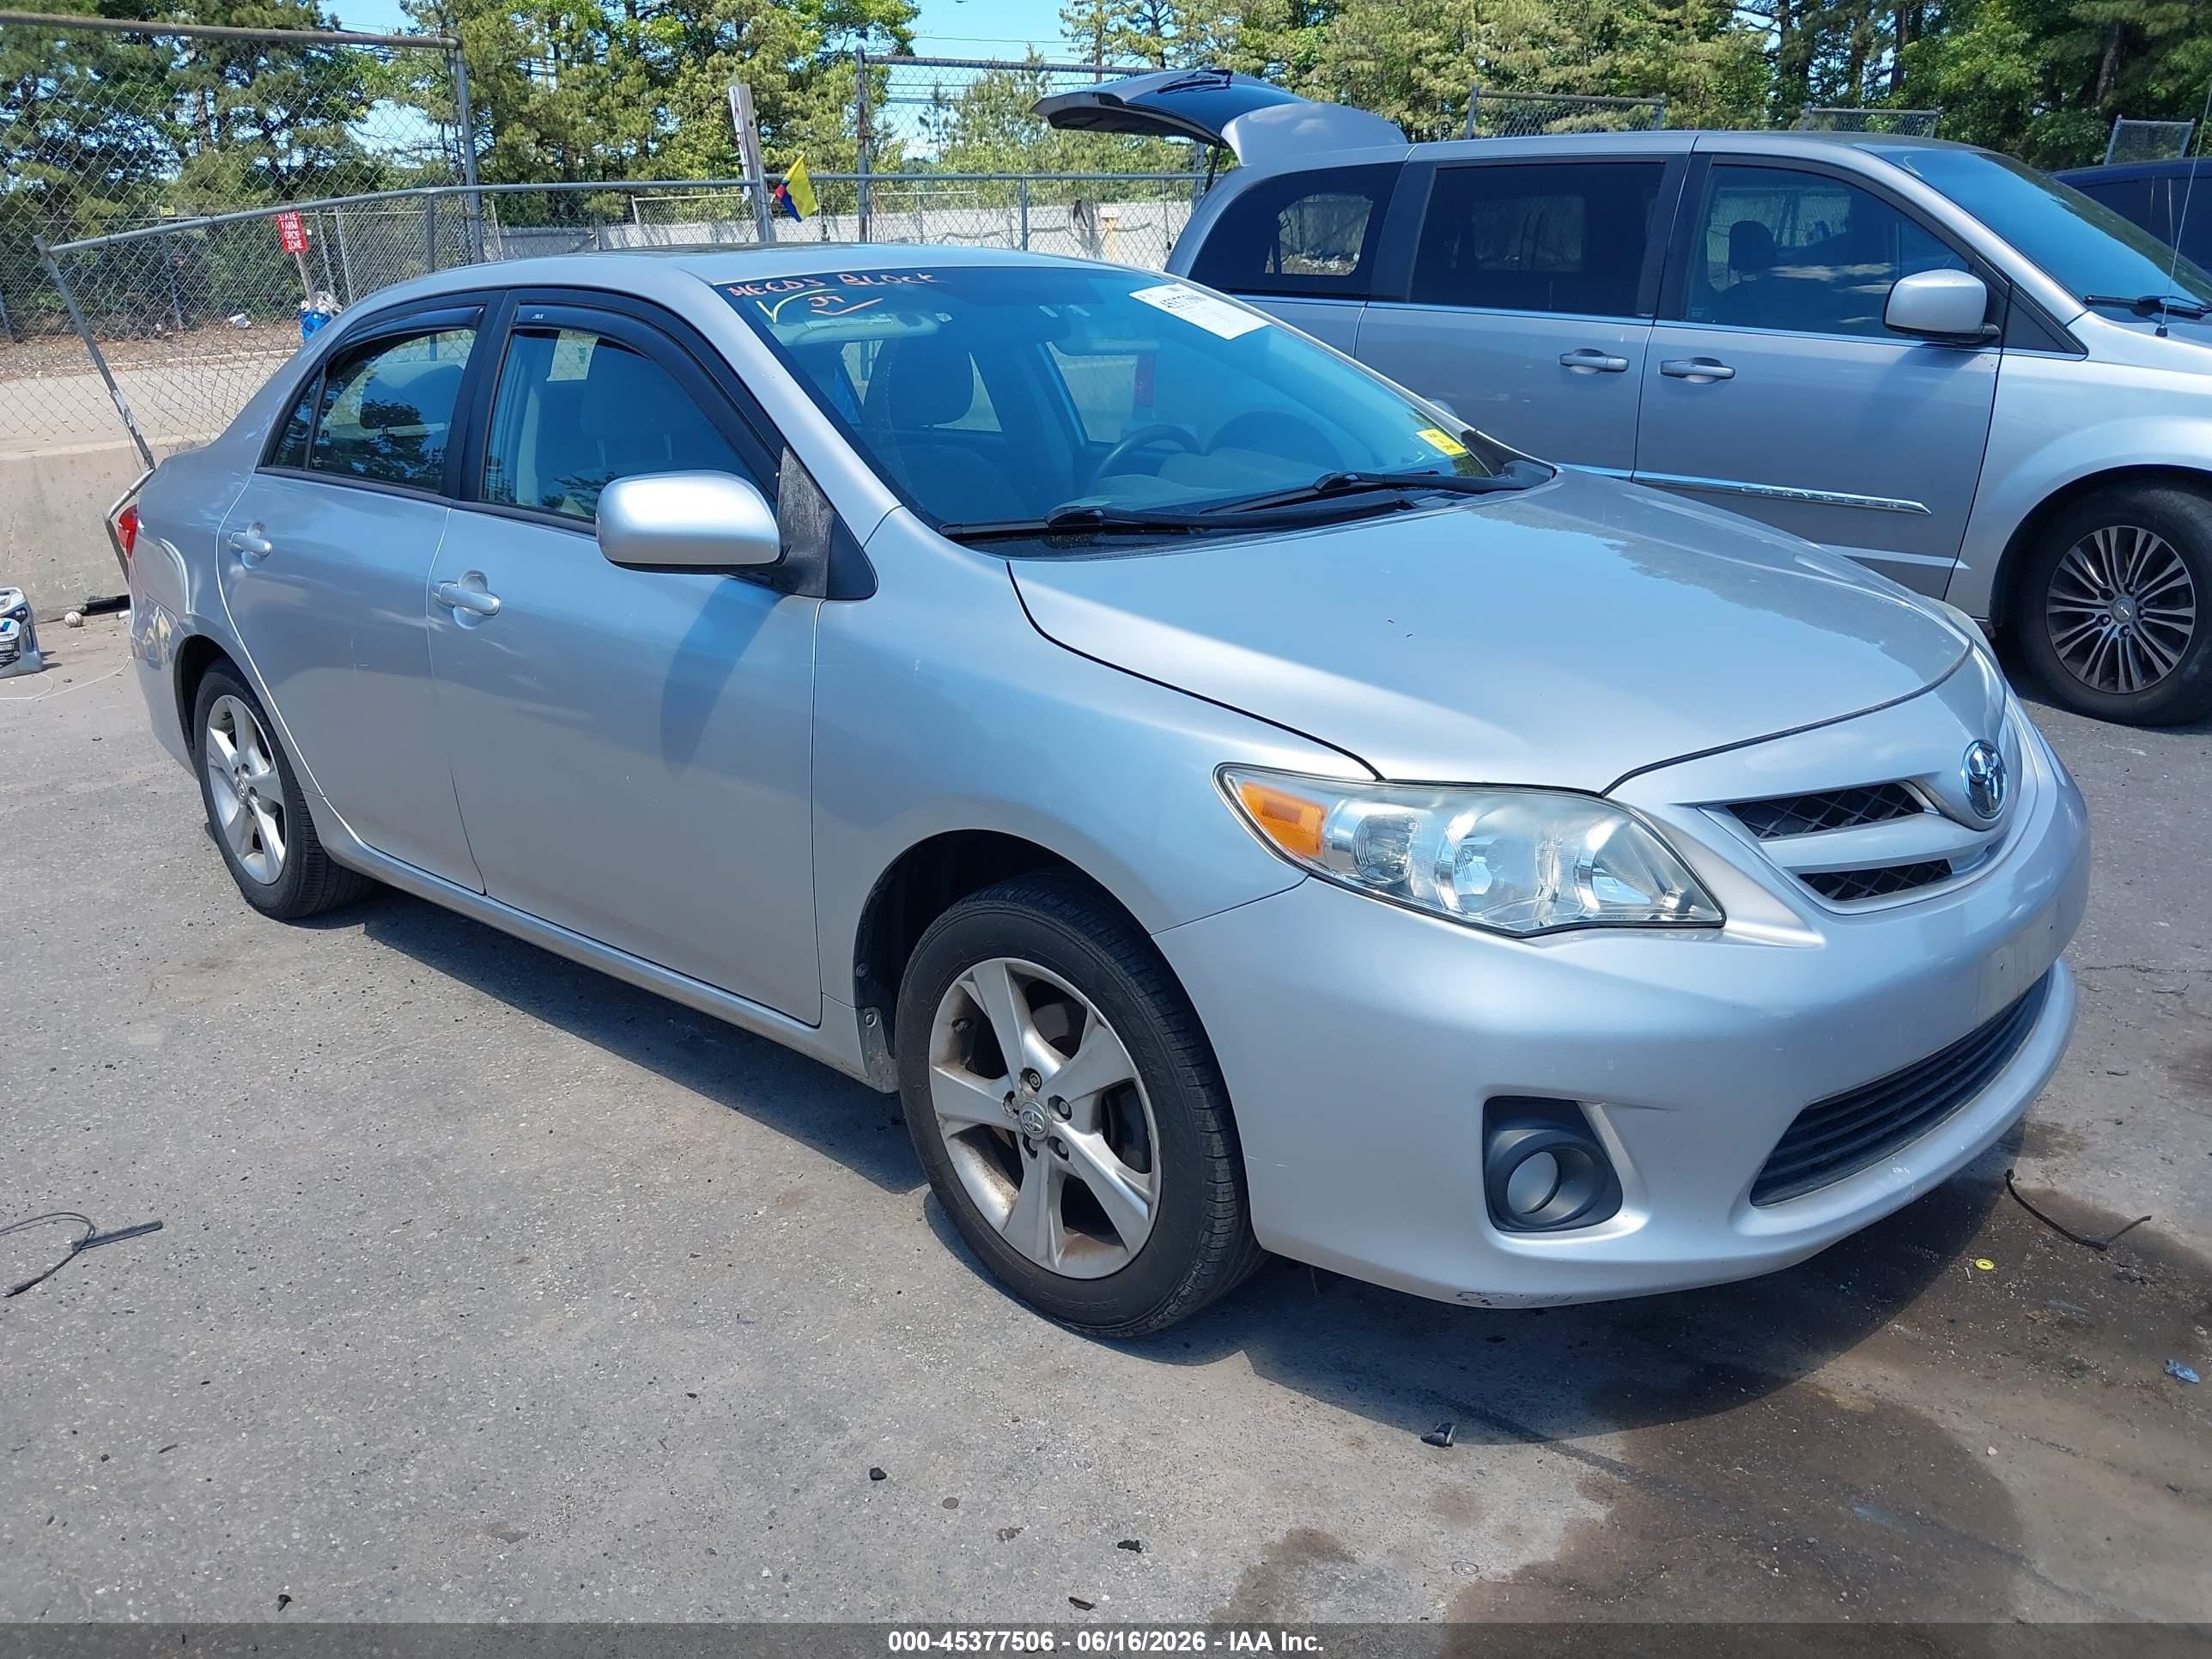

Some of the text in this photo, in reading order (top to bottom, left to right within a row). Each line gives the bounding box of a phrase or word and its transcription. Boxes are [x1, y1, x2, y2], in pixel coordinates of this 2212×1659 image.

[281, 221, 299, 230] FARM
[287, 240, 304, 249] ZONE
[726, 277, 826, 296] NEEDS
[1741, 485, 1899, 508] CHRYSLER
